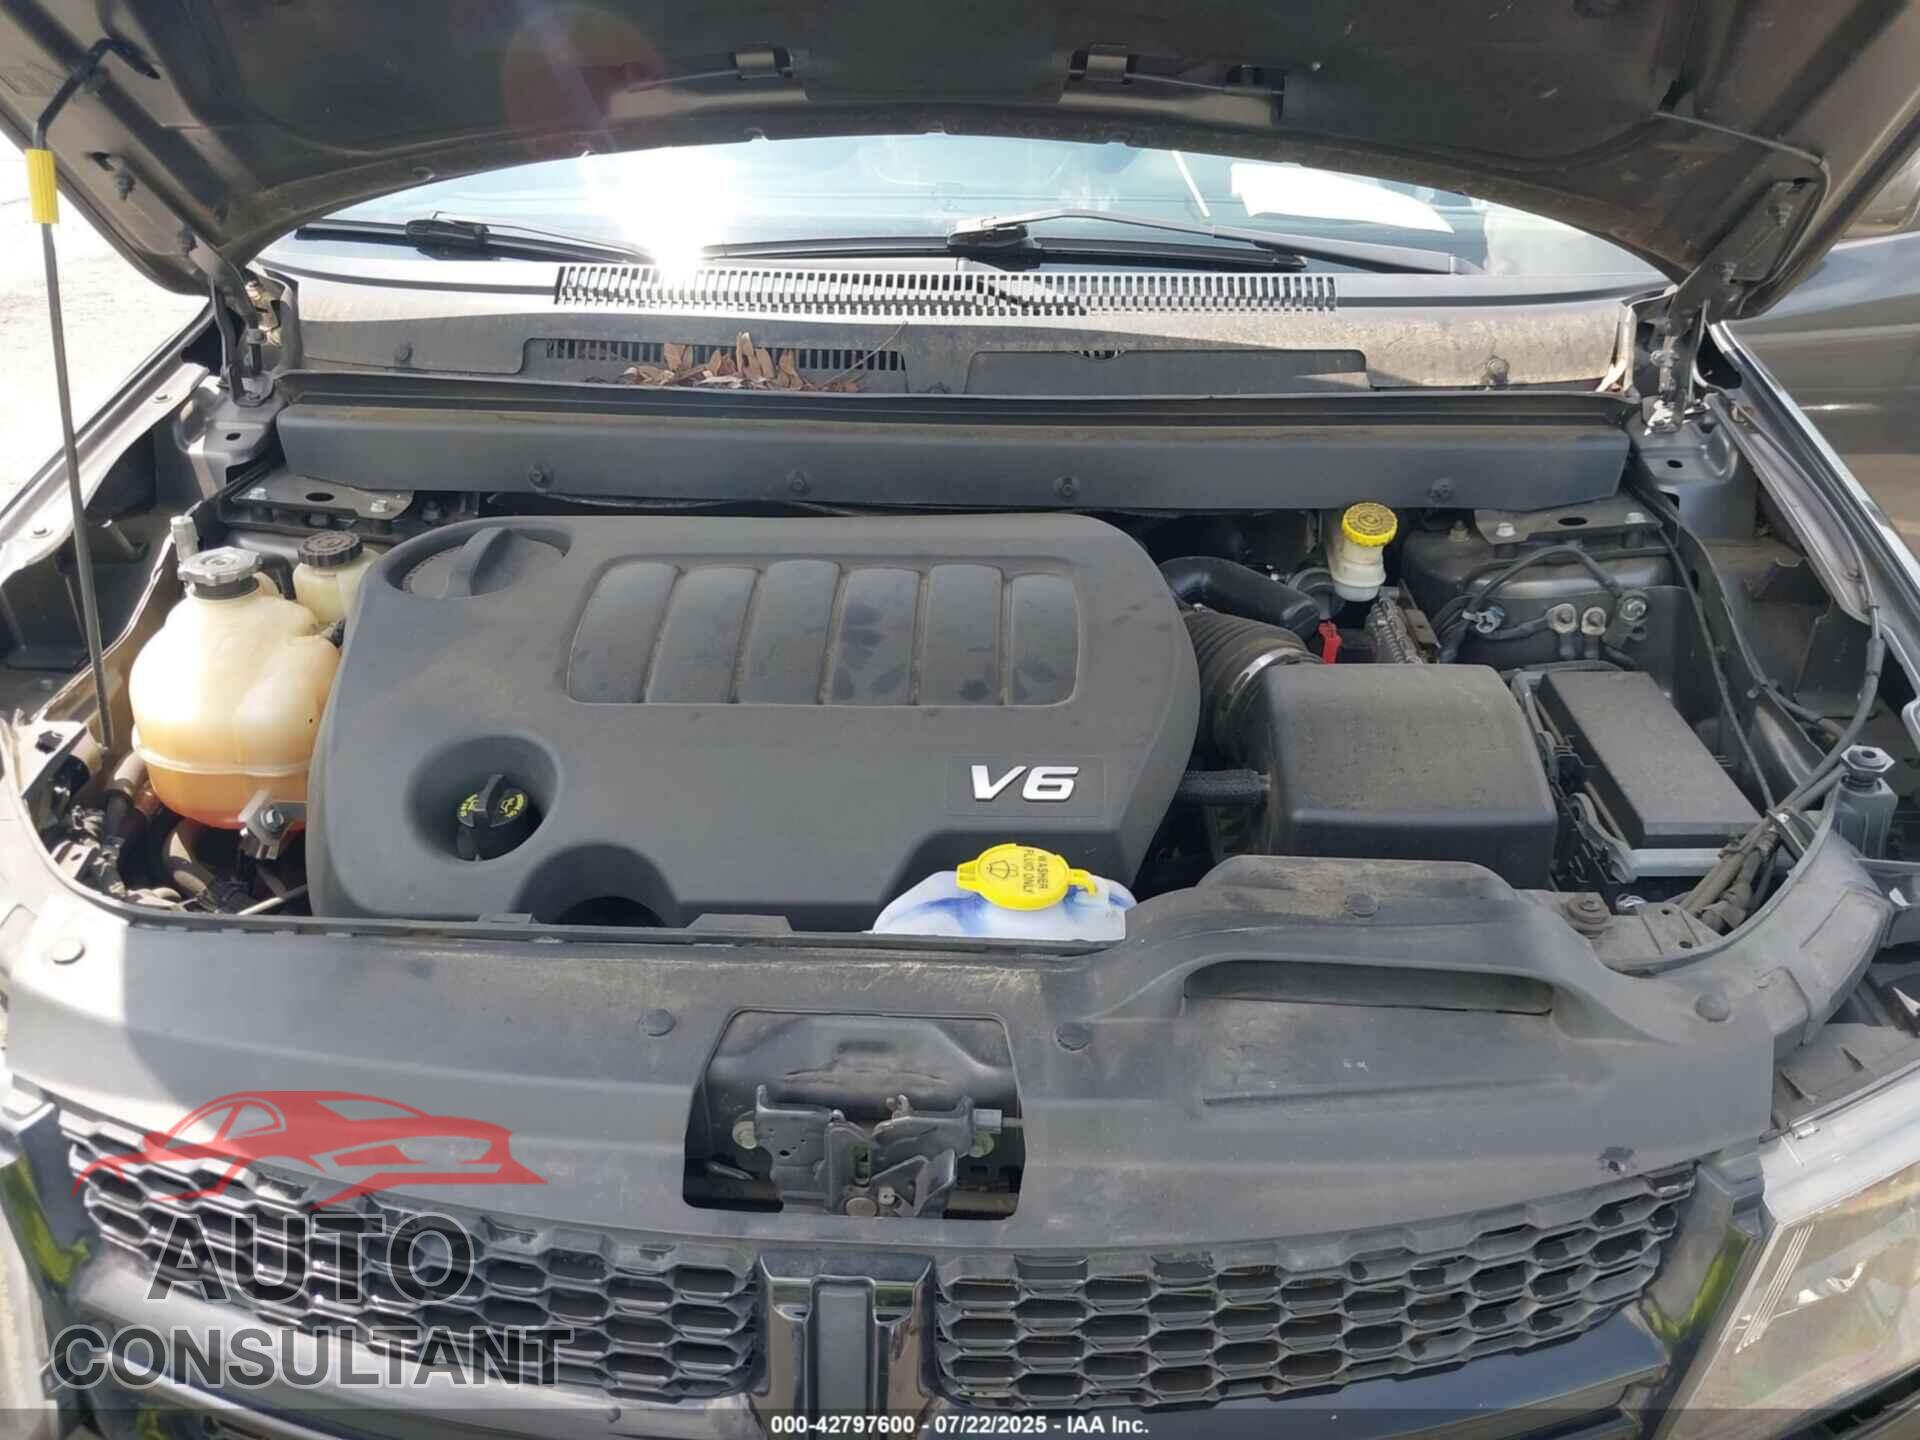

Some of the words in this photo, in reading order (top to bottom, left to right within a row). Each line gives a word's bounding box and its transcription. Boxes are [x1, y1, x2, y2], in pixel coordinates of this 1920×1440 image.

[971, 765, 1080, 801] V6
[1023, 849, 1035, 871] FLUID
[1037, 855, 1049, 889] WASHER
[1023, 873, 1035, 893] ONLY
